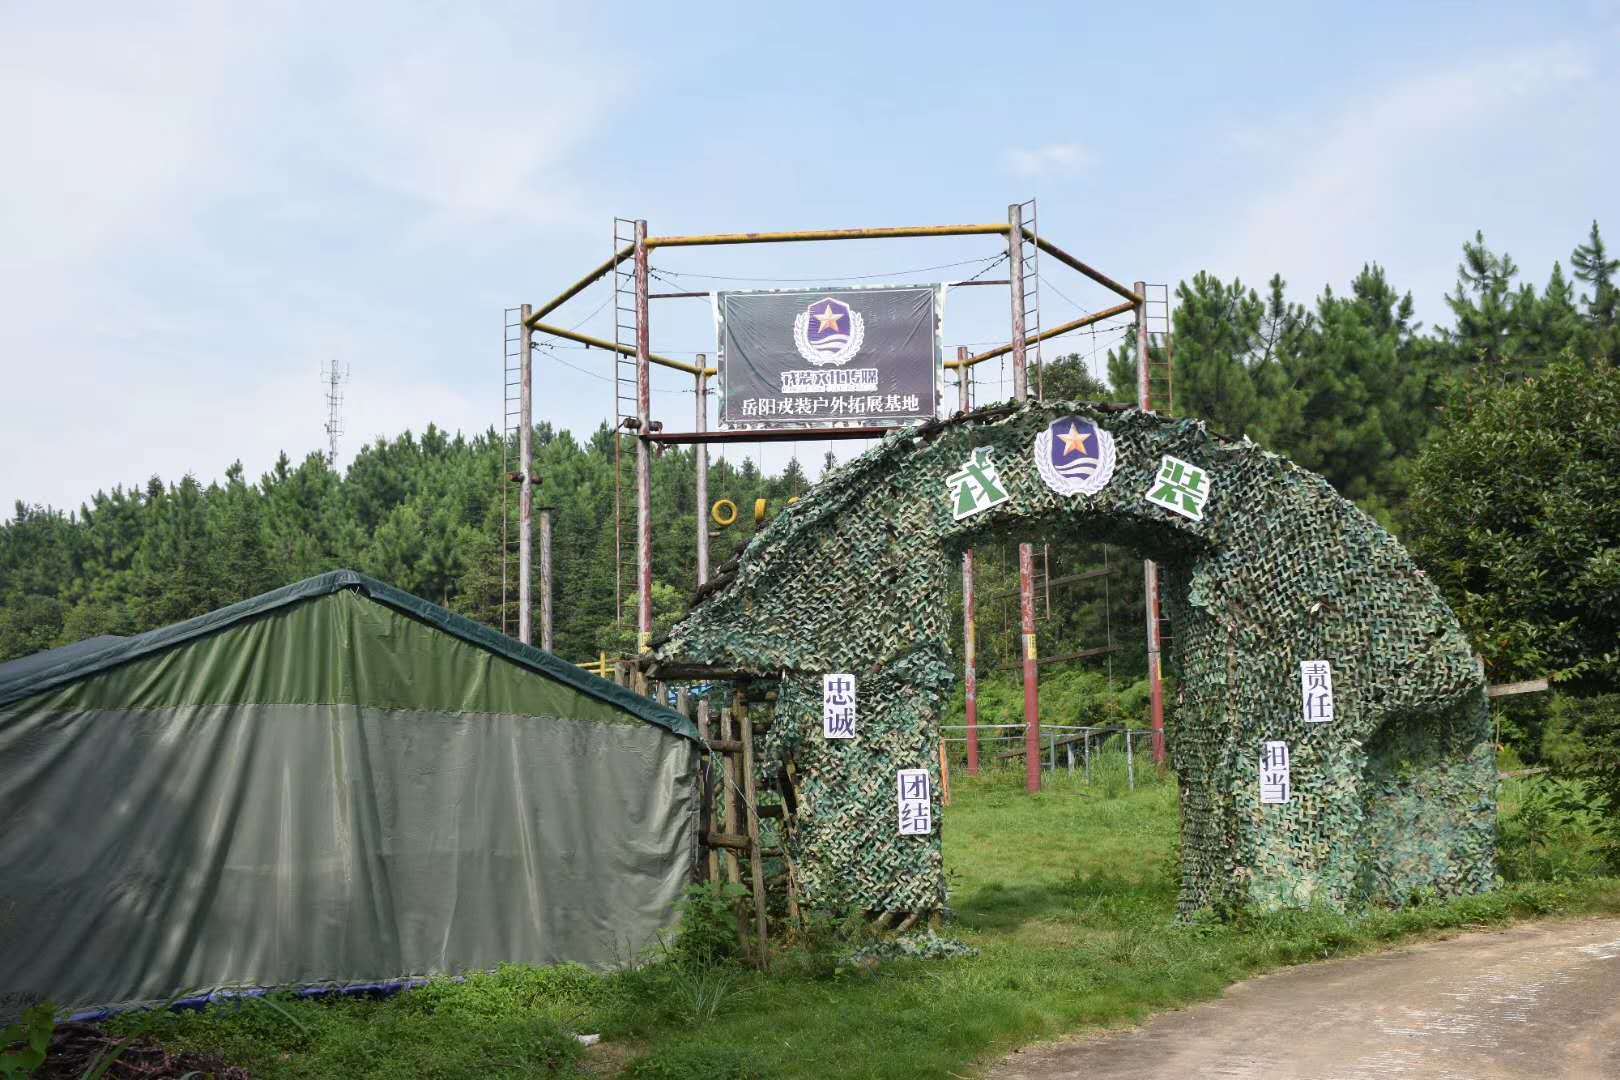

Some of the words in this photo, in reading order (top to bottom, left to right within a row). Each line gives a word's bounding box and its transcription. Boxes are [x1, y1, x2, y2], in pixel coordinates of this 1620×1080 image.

[742, 395, 920, 416] 岳阳戎装户外拓展基地
[948, 447, 1006, 515] 戎
[1150, 459, 1206, 517] 装
[826, 677, 853, 736] 忠诚
[1304, 664, 1331, 720] 责任
[1262, 745, 1287, 801] 担当
[901, 773, 928, 832] 团结
